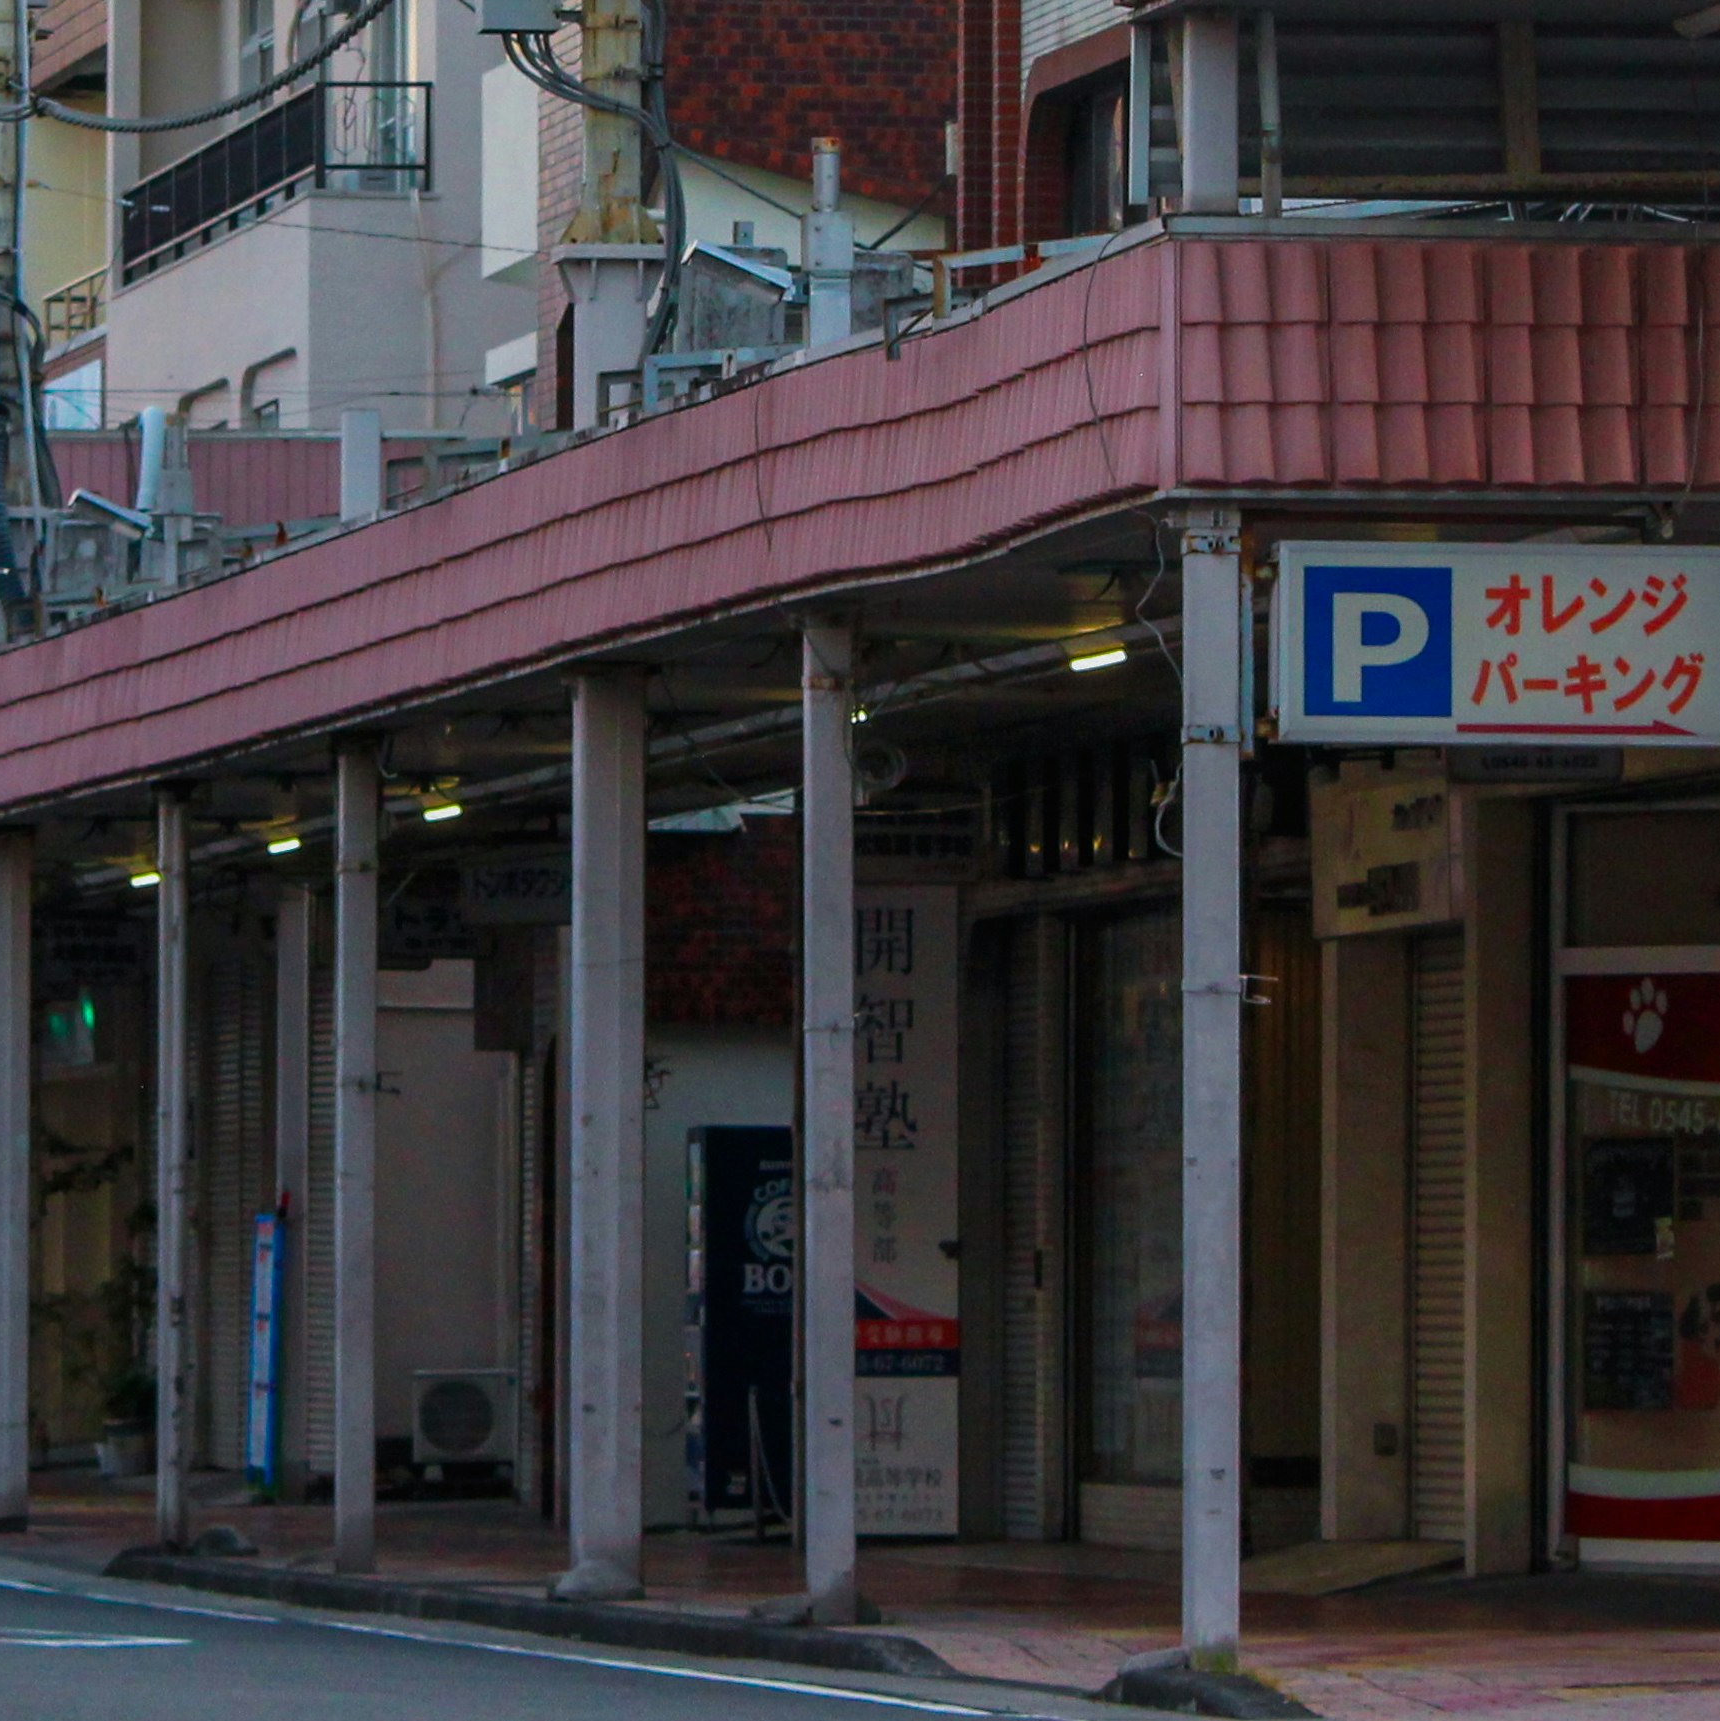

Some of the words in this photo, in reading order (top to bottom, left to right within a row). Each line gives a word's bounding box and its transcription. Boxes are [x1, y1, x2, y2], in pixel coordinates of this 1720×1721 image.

[1485, 574, 1688, 636] オレンジ
[1332, 592, 1429, 702] P
[1471, 652, 1704, 714] パーキング
[856, 907, 916, 1149] 開智塾
[742, 1262, 792, 1294] BO
